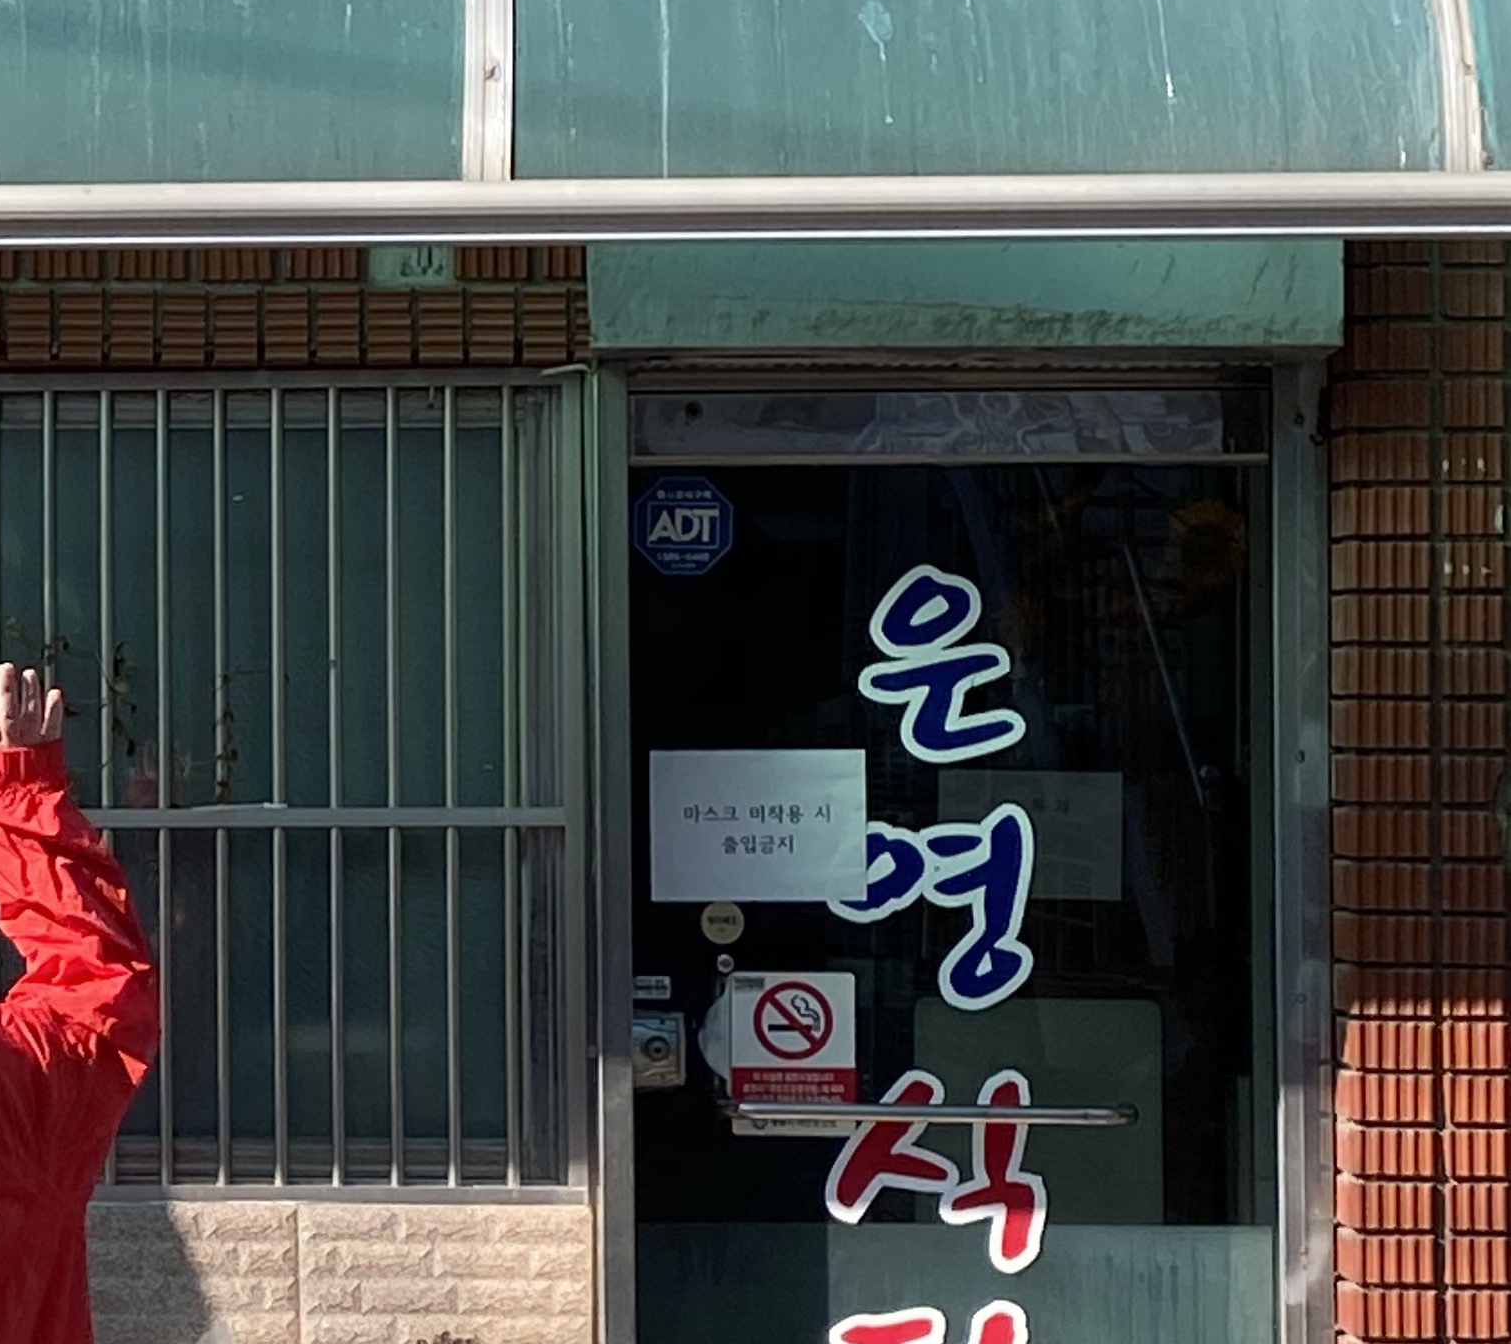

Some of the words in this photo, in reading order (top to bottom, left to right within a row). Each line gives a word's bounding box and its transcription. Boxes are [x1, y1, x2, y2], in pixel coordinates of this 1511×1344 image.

[648, 508, 719, 543] ADT
[683, 804, 739, 824] 마스크
[749, 804, 804, 824] 미착용
[814, 803, 831, 824] 시
[721, 835, 794, 854] 출입금지
